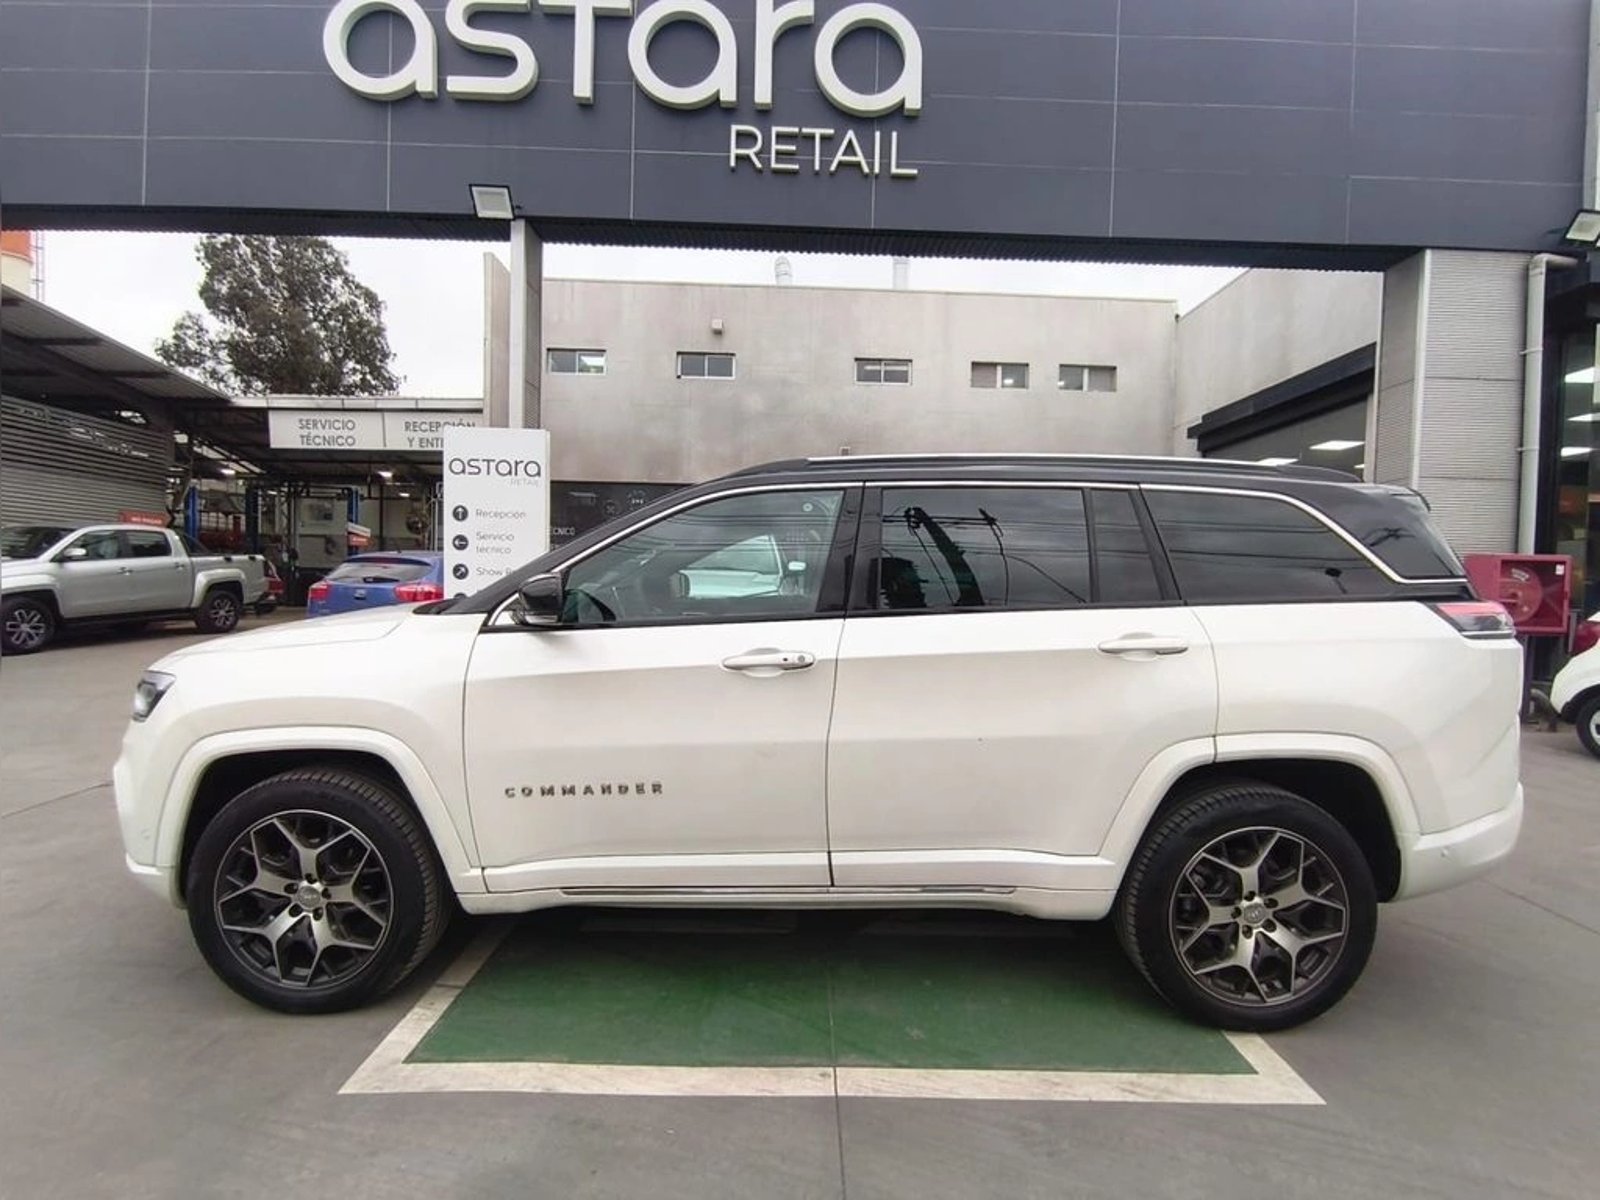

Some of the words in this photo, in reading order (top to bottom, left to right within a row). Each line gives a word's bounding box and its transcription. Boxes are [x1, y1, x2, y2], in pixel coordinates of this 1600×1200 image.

[729, 124, 919, 178] RETAIL
[298, 418, 356, 431] SERVICIO
[300, 432, 356, 447] TÉCNICO
[407, 436, 415, 448] Y
[448, 457, 541, 478] astara
[475, 566, 503, 577] Show
[504, 782, 664, 799] COMMANDER
